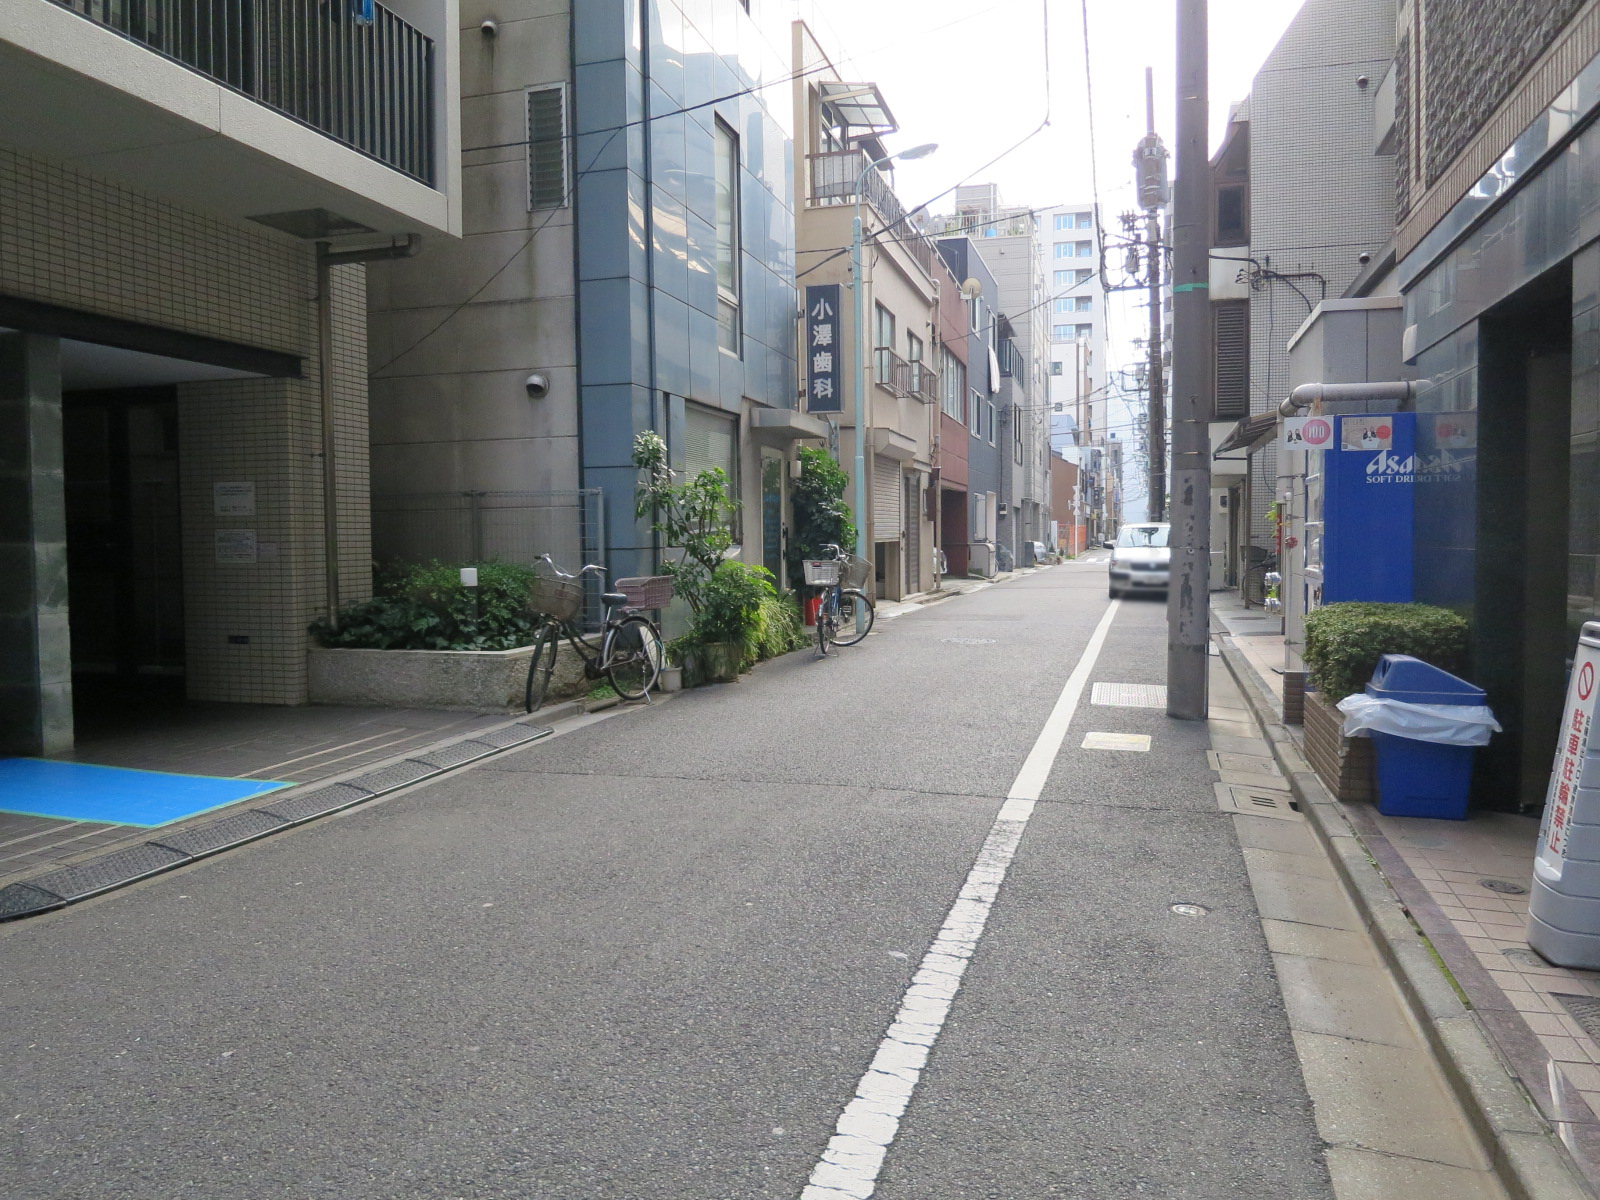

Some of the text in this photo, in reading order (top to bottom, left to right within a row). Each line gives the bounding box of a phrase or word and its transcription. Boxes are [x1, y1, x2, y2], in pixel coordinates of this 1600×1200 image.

[811, 297, 834, 399] 小澤歯科
[1308, 425, 1325, 439] 100
[1366, 449, 1416, 475] Asa
[1366, 475, 1416, 484] SOFT DRI
[1549, 708, 1585, 854] 駐車駐輪禁止
